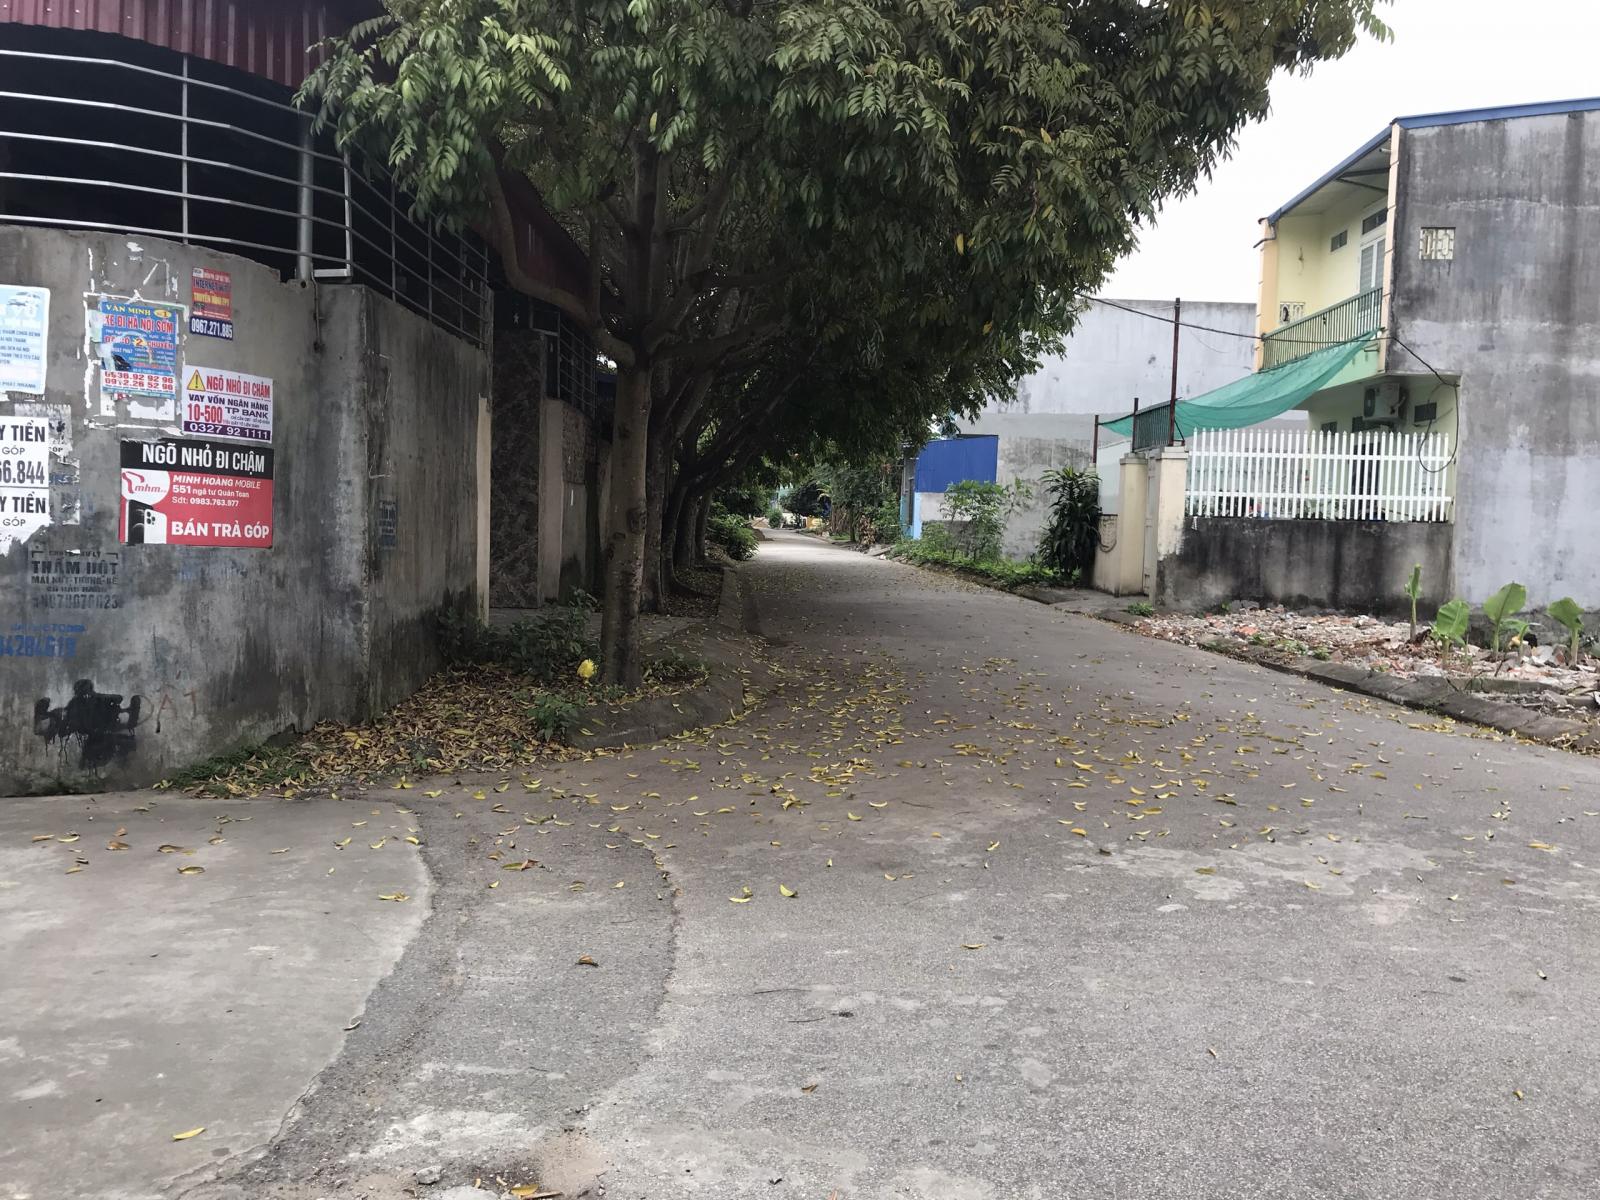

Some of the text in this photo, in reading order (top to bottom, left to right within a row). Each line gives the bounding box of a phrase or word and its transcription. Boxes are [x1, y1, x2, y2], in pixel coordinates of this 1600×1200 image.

[128, 308, 150, 316] MINH
[116, 315, 126, 327] ĐI
[128, 315, 138, 329] HÀ
[140, 318, 153, 332] NỘI
[156, 319, 174, 333] SỚM
[136, 338, 144, 346] 2
[207, 375, 224, 391] NGÕ
[226, 376, 241, 394] NHỎ
[243, 380, 250, 395] ĐI
[189, 394, 269, 412] VAY VỐN NGÂN HÀNG
[188, 403, 223, 424] 10-500
[225, 407, 269, 420] TP BANK
[11, 420, 46, 442] TIỀN
[190, 422, 222, 434] 0327
[226, 426, 240, 435] 92
[245, 429, 267, 439] 1111
[2, 445, 25, 455] GÓP
[143, 443, 264, 475] NGÕ NHỎ ĐI CHẬM
[0, 460, 45, 484] 6.844
[173, 475, 261, 489] MINH HOÀNG MOBILE
[172, 485, 191, 493] 551
[192, 487, 207, 496] ngã
[218, 489, 235, 497] Quán
[236, 490, 249, 498] Toan
[12, 491, 46, 513] TIỀN
[2, 516, 26, 526] GÓP
[172, 518, 208, 536] BÁN
[244, 521, 269, 539] GÓP
